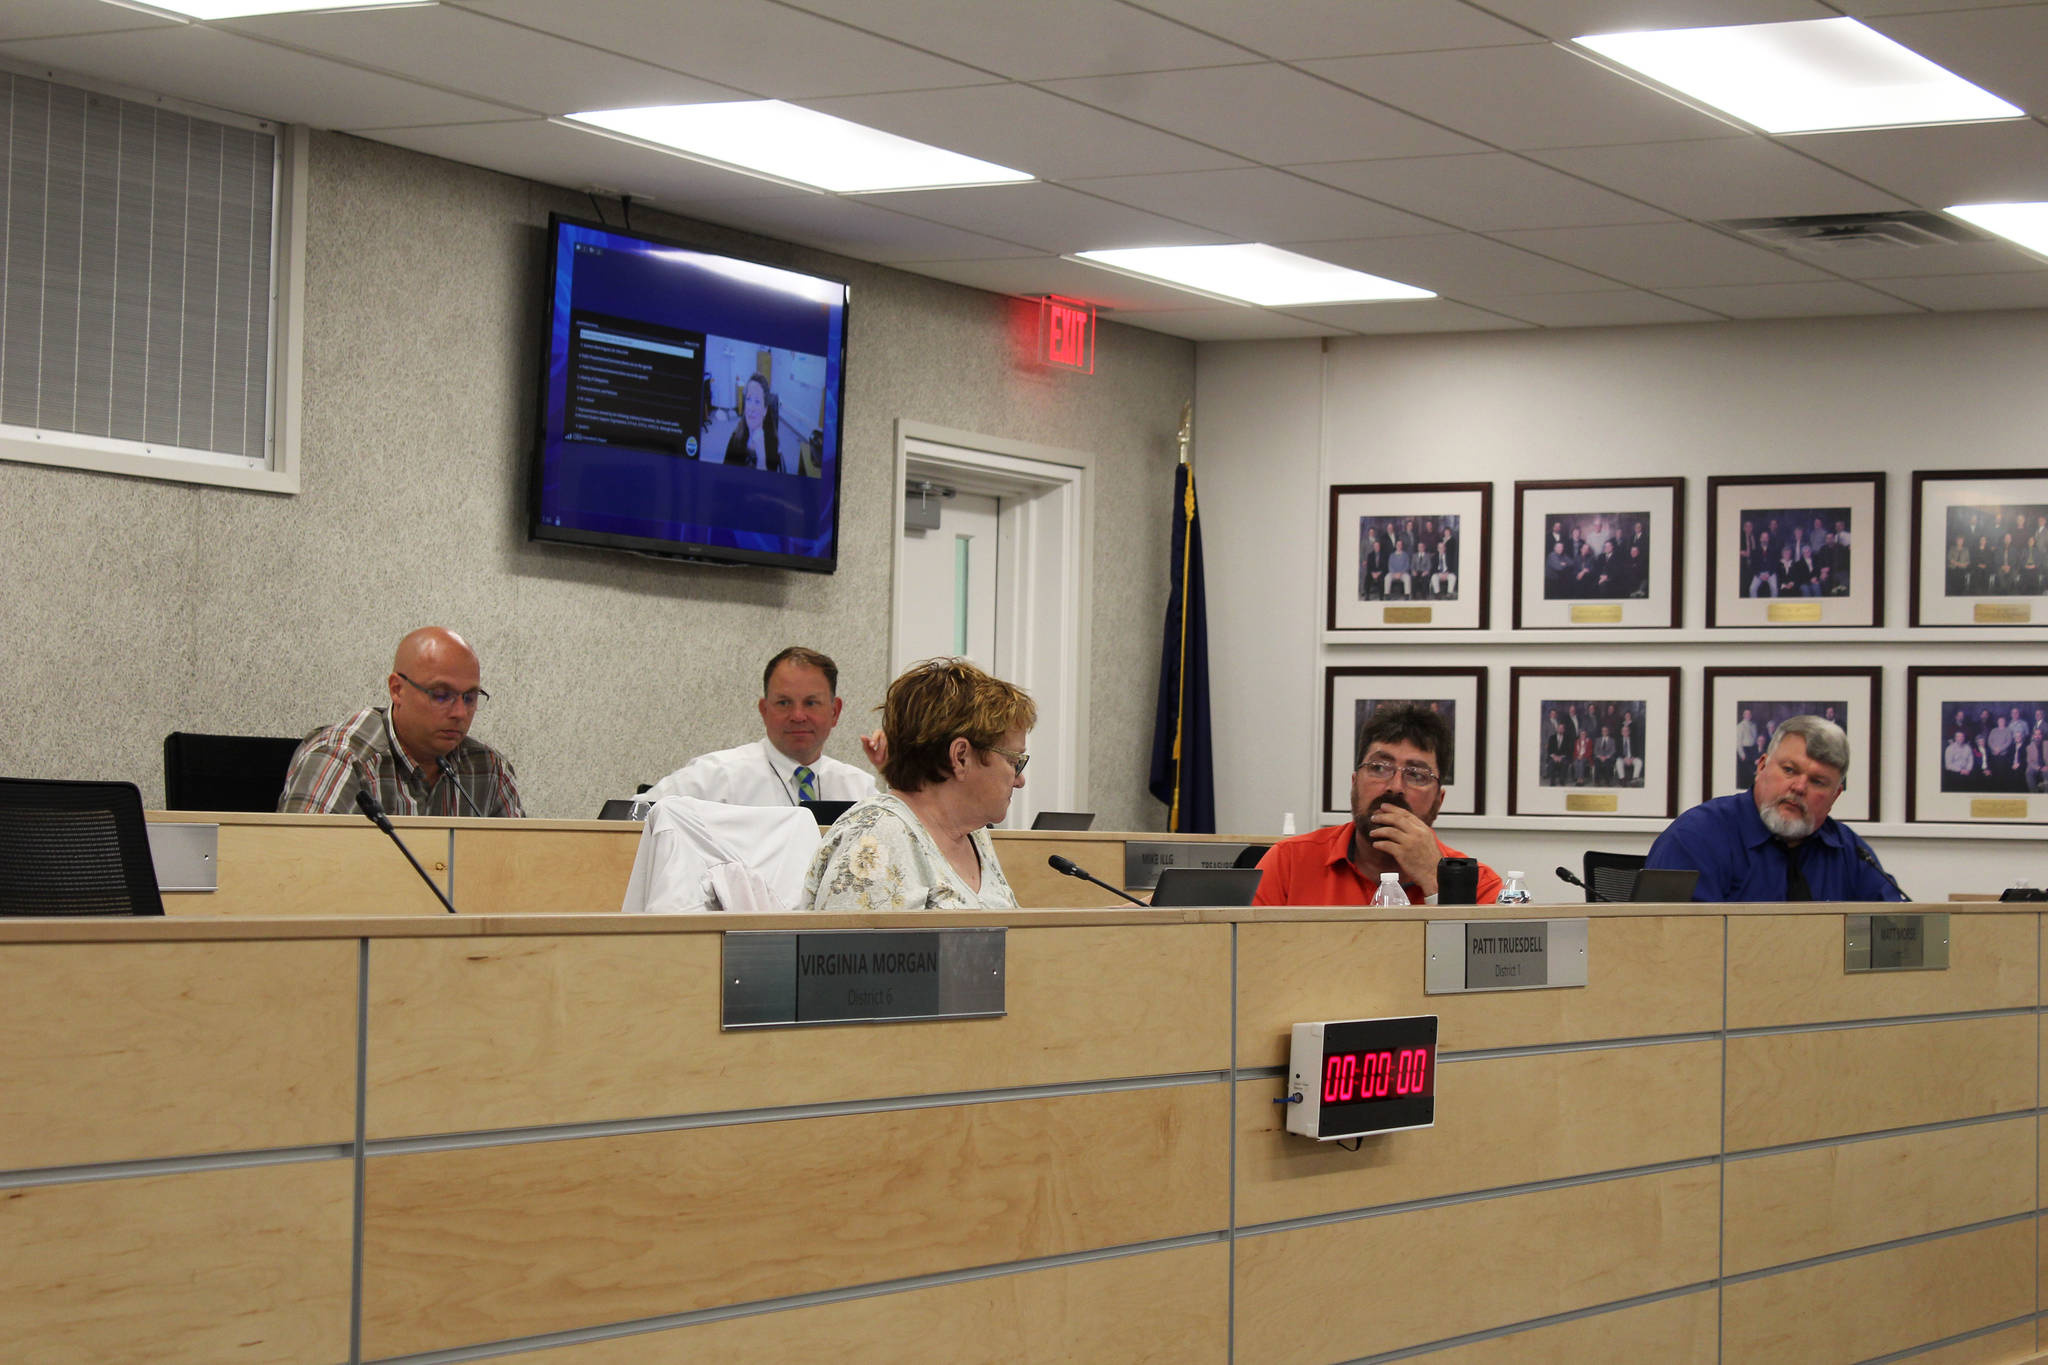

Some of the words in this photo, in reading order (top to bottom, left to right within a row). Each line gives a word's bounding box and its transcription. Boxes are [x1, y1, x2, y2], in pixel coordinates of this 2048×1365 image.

[1049, 305, 1087, 367] EXIT
[1472, 937, 1496, 954] PATTI
[1498, 936, 1543, 953] TRUESDELL
[800, 953, 868, 976] VIRGINIA
[872, 951, 937, 974] MORGAN
[1495, 964, 1516, 977] District
[848, 988, 884, 1006] District
[886, 987, 894, 1005] 6
[1324, 1049, 1427, 1103] 00:00:00
